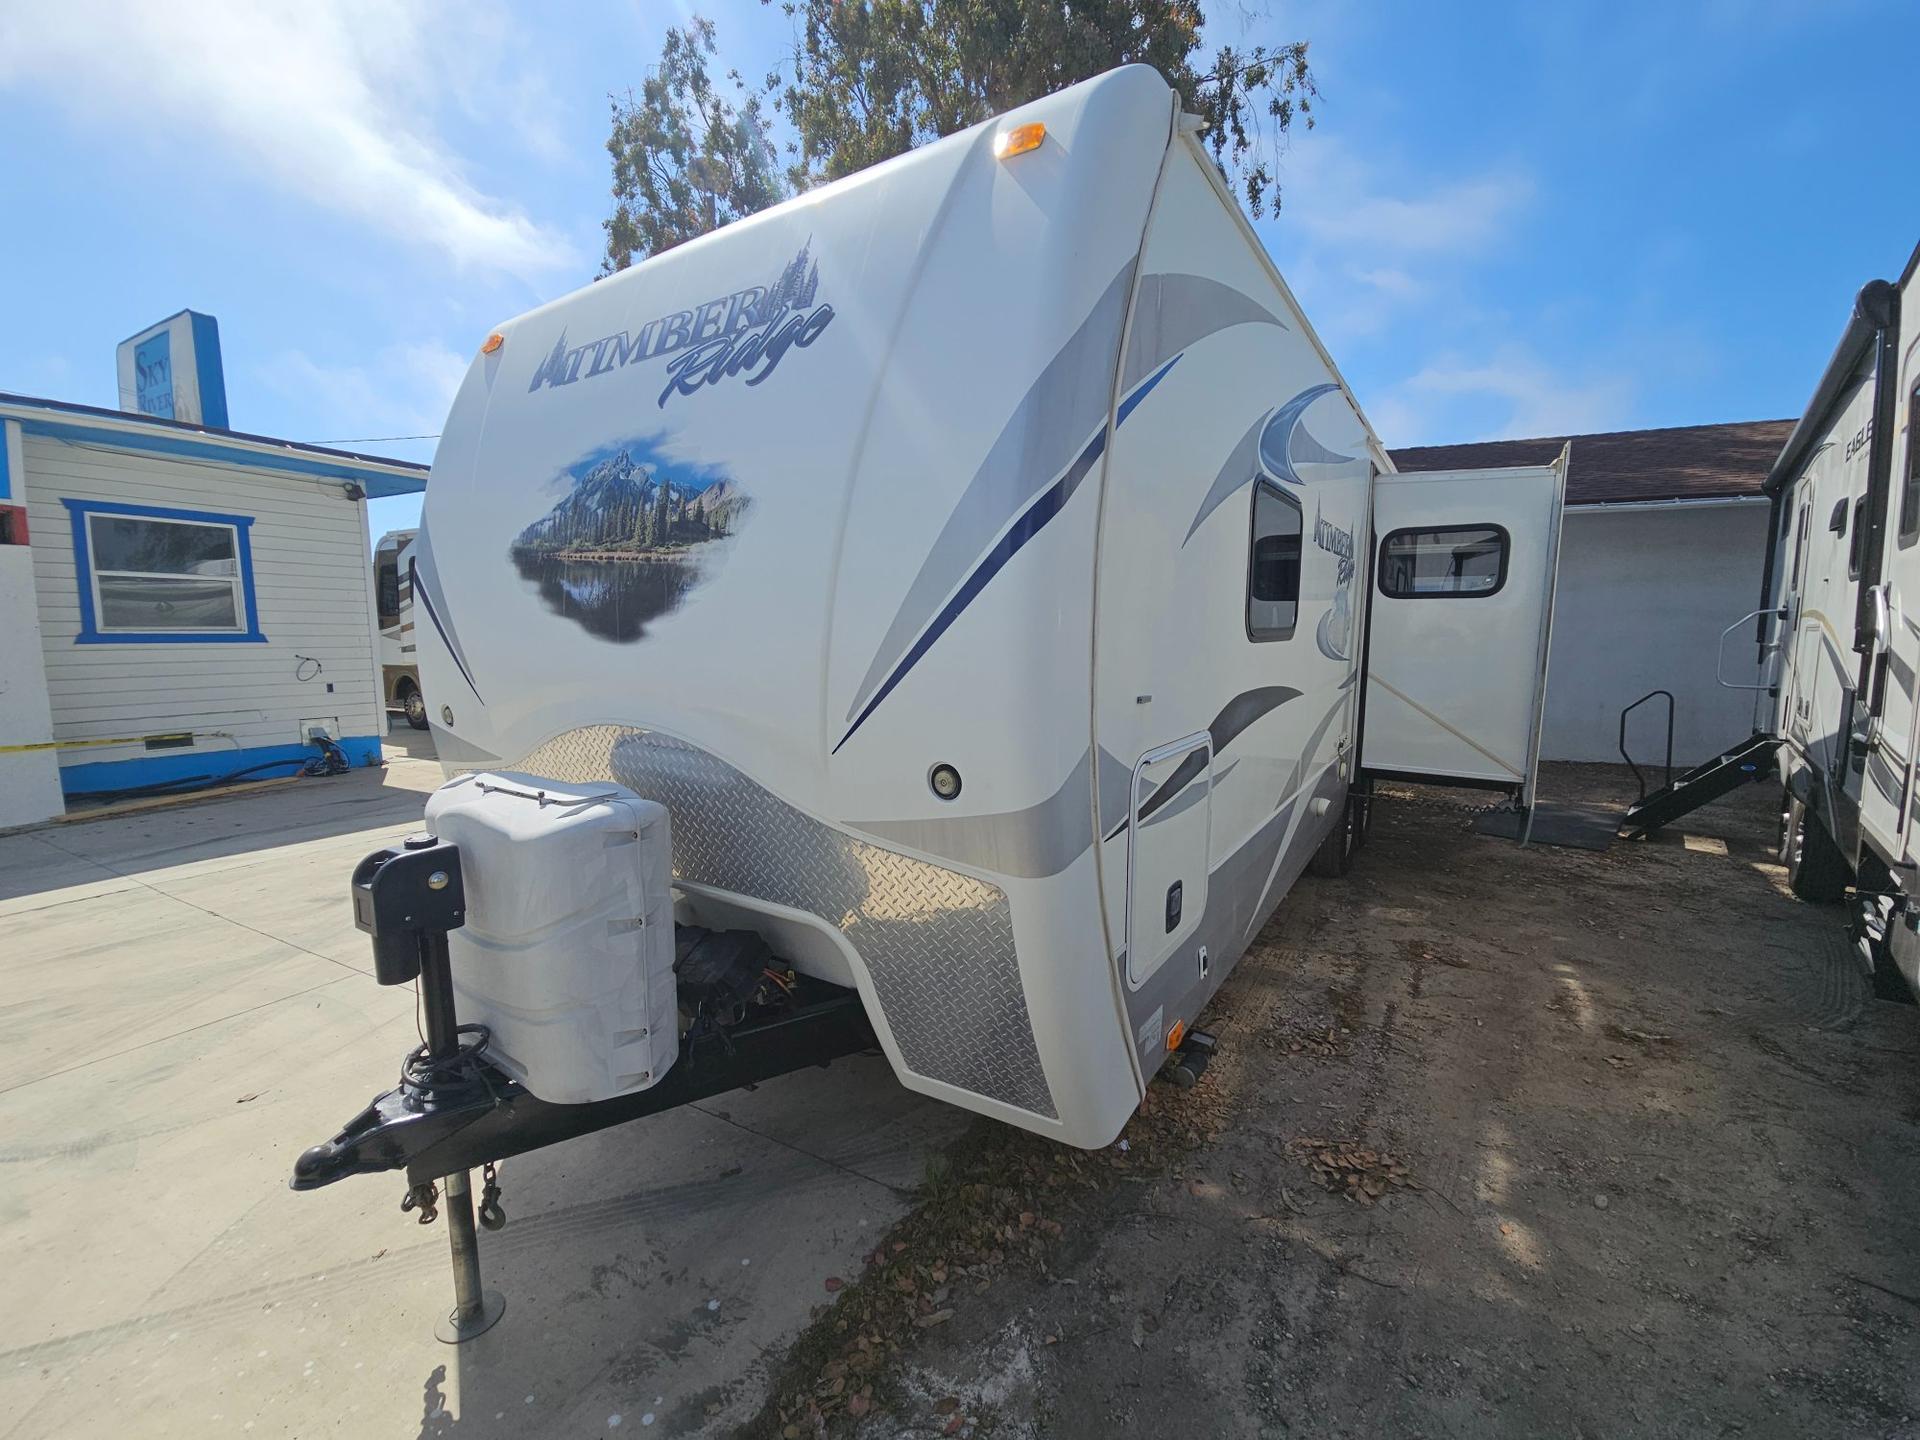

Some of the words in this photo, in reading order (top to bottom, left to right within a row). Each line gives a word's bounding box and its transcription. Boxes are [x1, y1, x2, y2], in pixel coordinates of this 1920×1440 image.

[550, 286, 773, 387] TIMBER
[657, 303, 835, 409] Ridge
[1845, 418, 1873, 463] EAGLE
